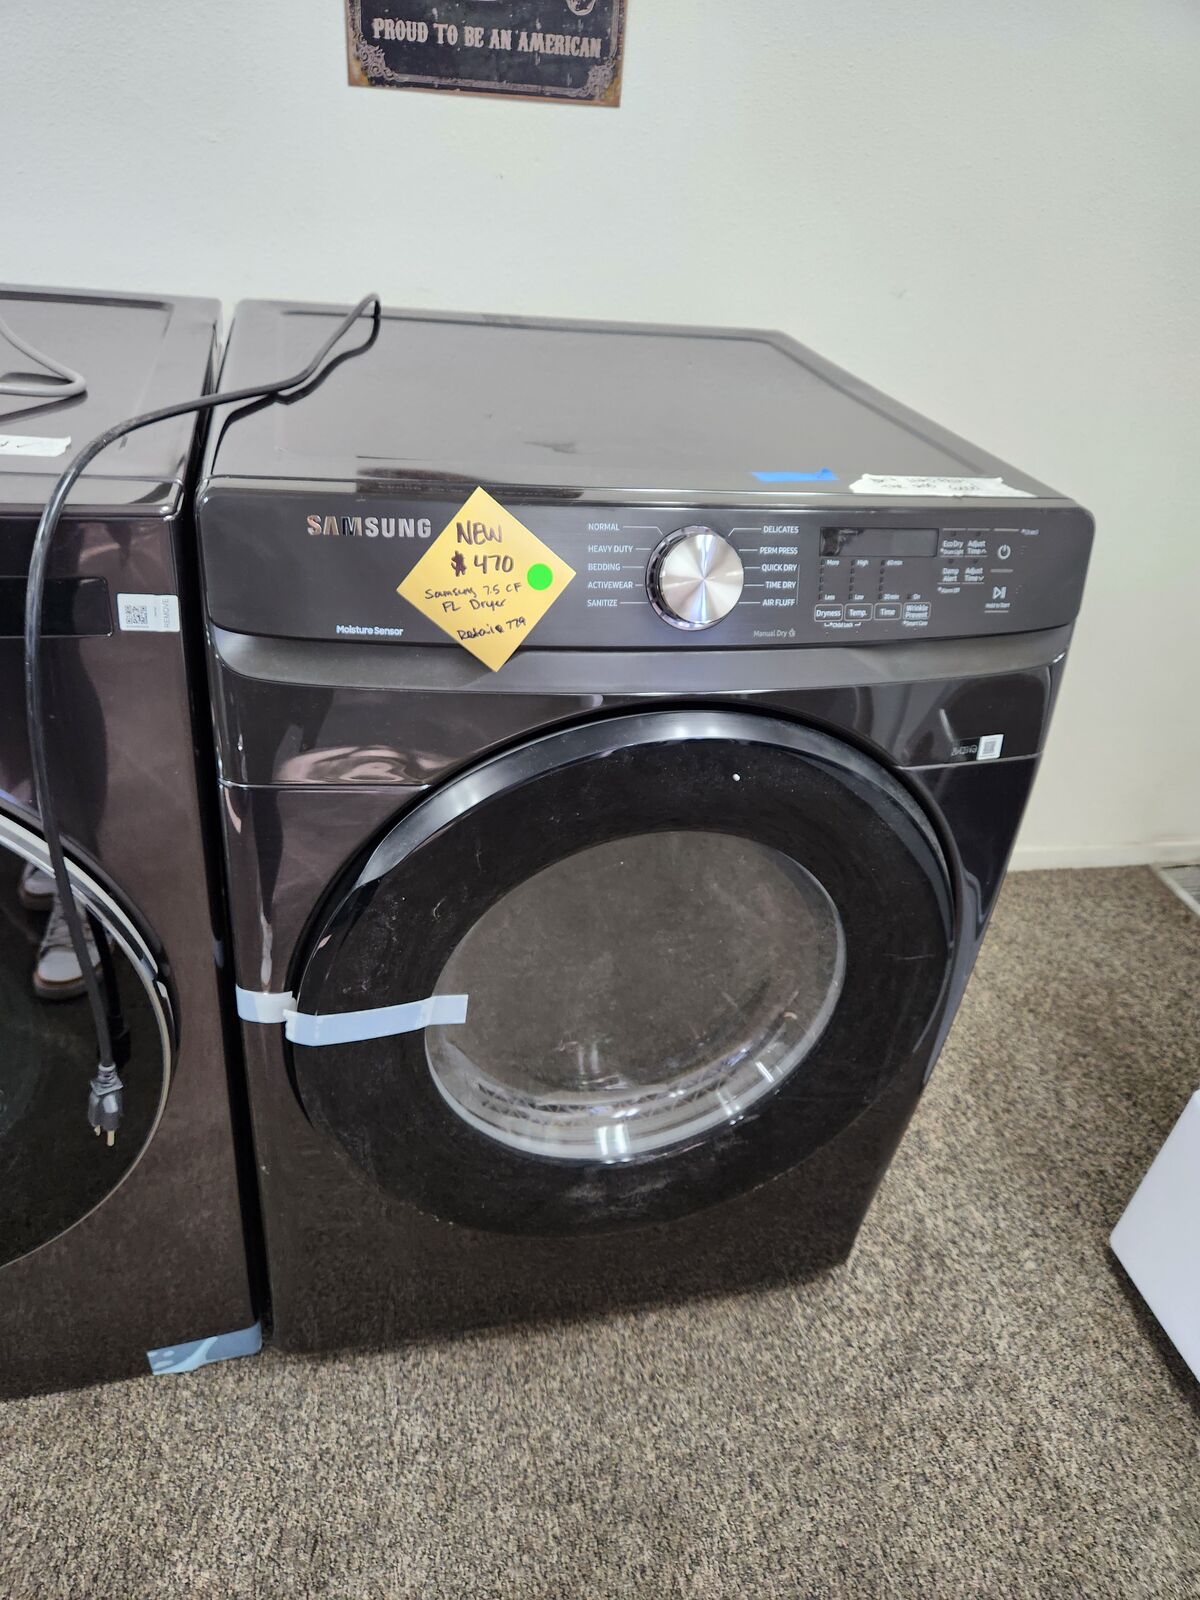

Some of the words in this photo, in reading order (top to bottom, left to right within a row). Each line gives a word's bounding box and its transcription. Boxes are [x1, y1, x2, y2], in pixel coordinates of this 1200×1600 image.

[372, 17, 428, 43] PROUD
[433, 23, 458, 46] TO
[464, 26, 484, 48] BE
[489, 28, 512, 51] AN
[517, 31, 602, 58] AMERICAN
[306, 514, 432, 539] SAMSUNG
[588, 523, 619, 531] NORMAL
[763, 525, 799, 534] DELICATES
[456, 520, 503, 545] NEW
[588, 545, 612, 553] HEAVY
[613, 545, 633, 553] DUTY
[759, 547, 778, 555] PERM
[778, 547, 798, 555] PRESS
[588, 563, 621, 571] BEDDING
[761, 564, 782, 572] QUICK
[783, 564, 797, 572] DRY
[587, 581, 633, 589] ACTIVEWEAR
[765, 581, 781, 589] TIME
[782, 581, 797, 589] DRY
[424, 587, 477, 600] Samsung
[482, 584, 500, 596] 7.5
[505, 582, 522, 593] CF
[442, 601, 461, 613] FL
[469, 599, 506, 612] Dryer
[587, 599, 618, 607] SANITIZE
[763, 599, 774, 607] AIR
[775, 599, 795, 607] FLUFF
[816, 609, 841, 619] Dryness
[880, 608, 896, 616] Time
[336, 624, 373, 636] Moisture
[373, 625, 404, 636] Sensor
[753, 630, 775, 638] Manual
[776, 630, 788, 639] Dry
